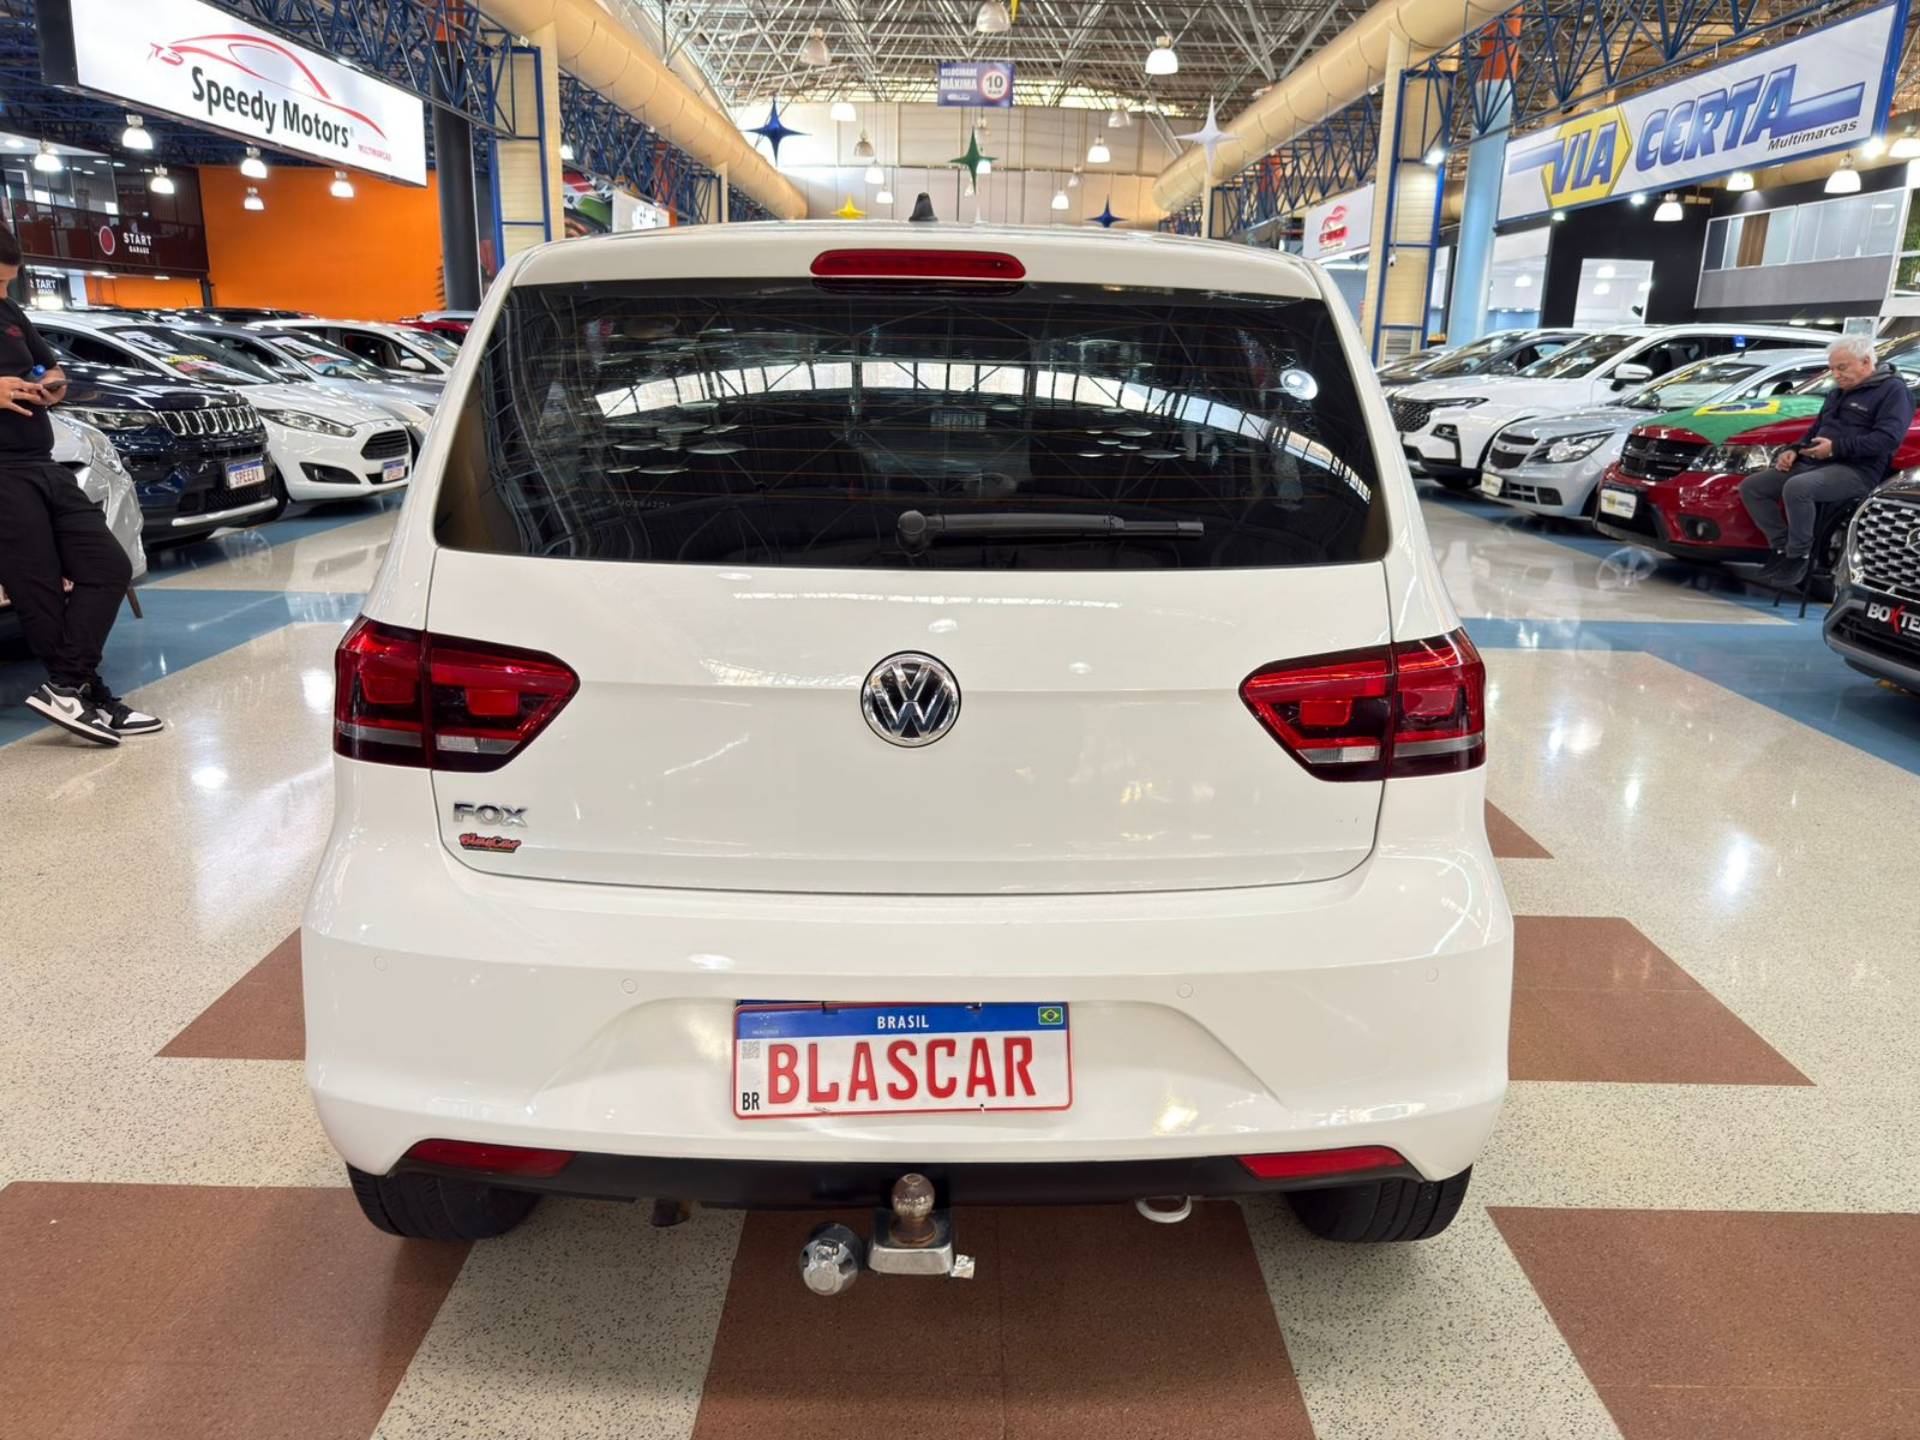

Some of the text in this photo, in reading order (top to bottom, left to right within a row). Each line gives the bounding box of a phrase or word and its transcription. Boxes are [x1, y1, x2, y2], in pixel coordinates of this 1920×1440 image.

[986, 75, 1004, 89] 10
[191, 66, 349, 149] Speedy Motors
[1545, 64, 1798, 195] VIA CERTA
[1767, 120, 1858, 152] Multimarcas
[123, 232, 152, 246] START
[235, 469, 260, 485] SPEEDY
[453, 803, 528, 828] FOX
[876, 1016, 929, 1030] BRASIL
[767, 1037, 1036, 1105] BLASCAR
[742, 1092, 760, 1111] BR
